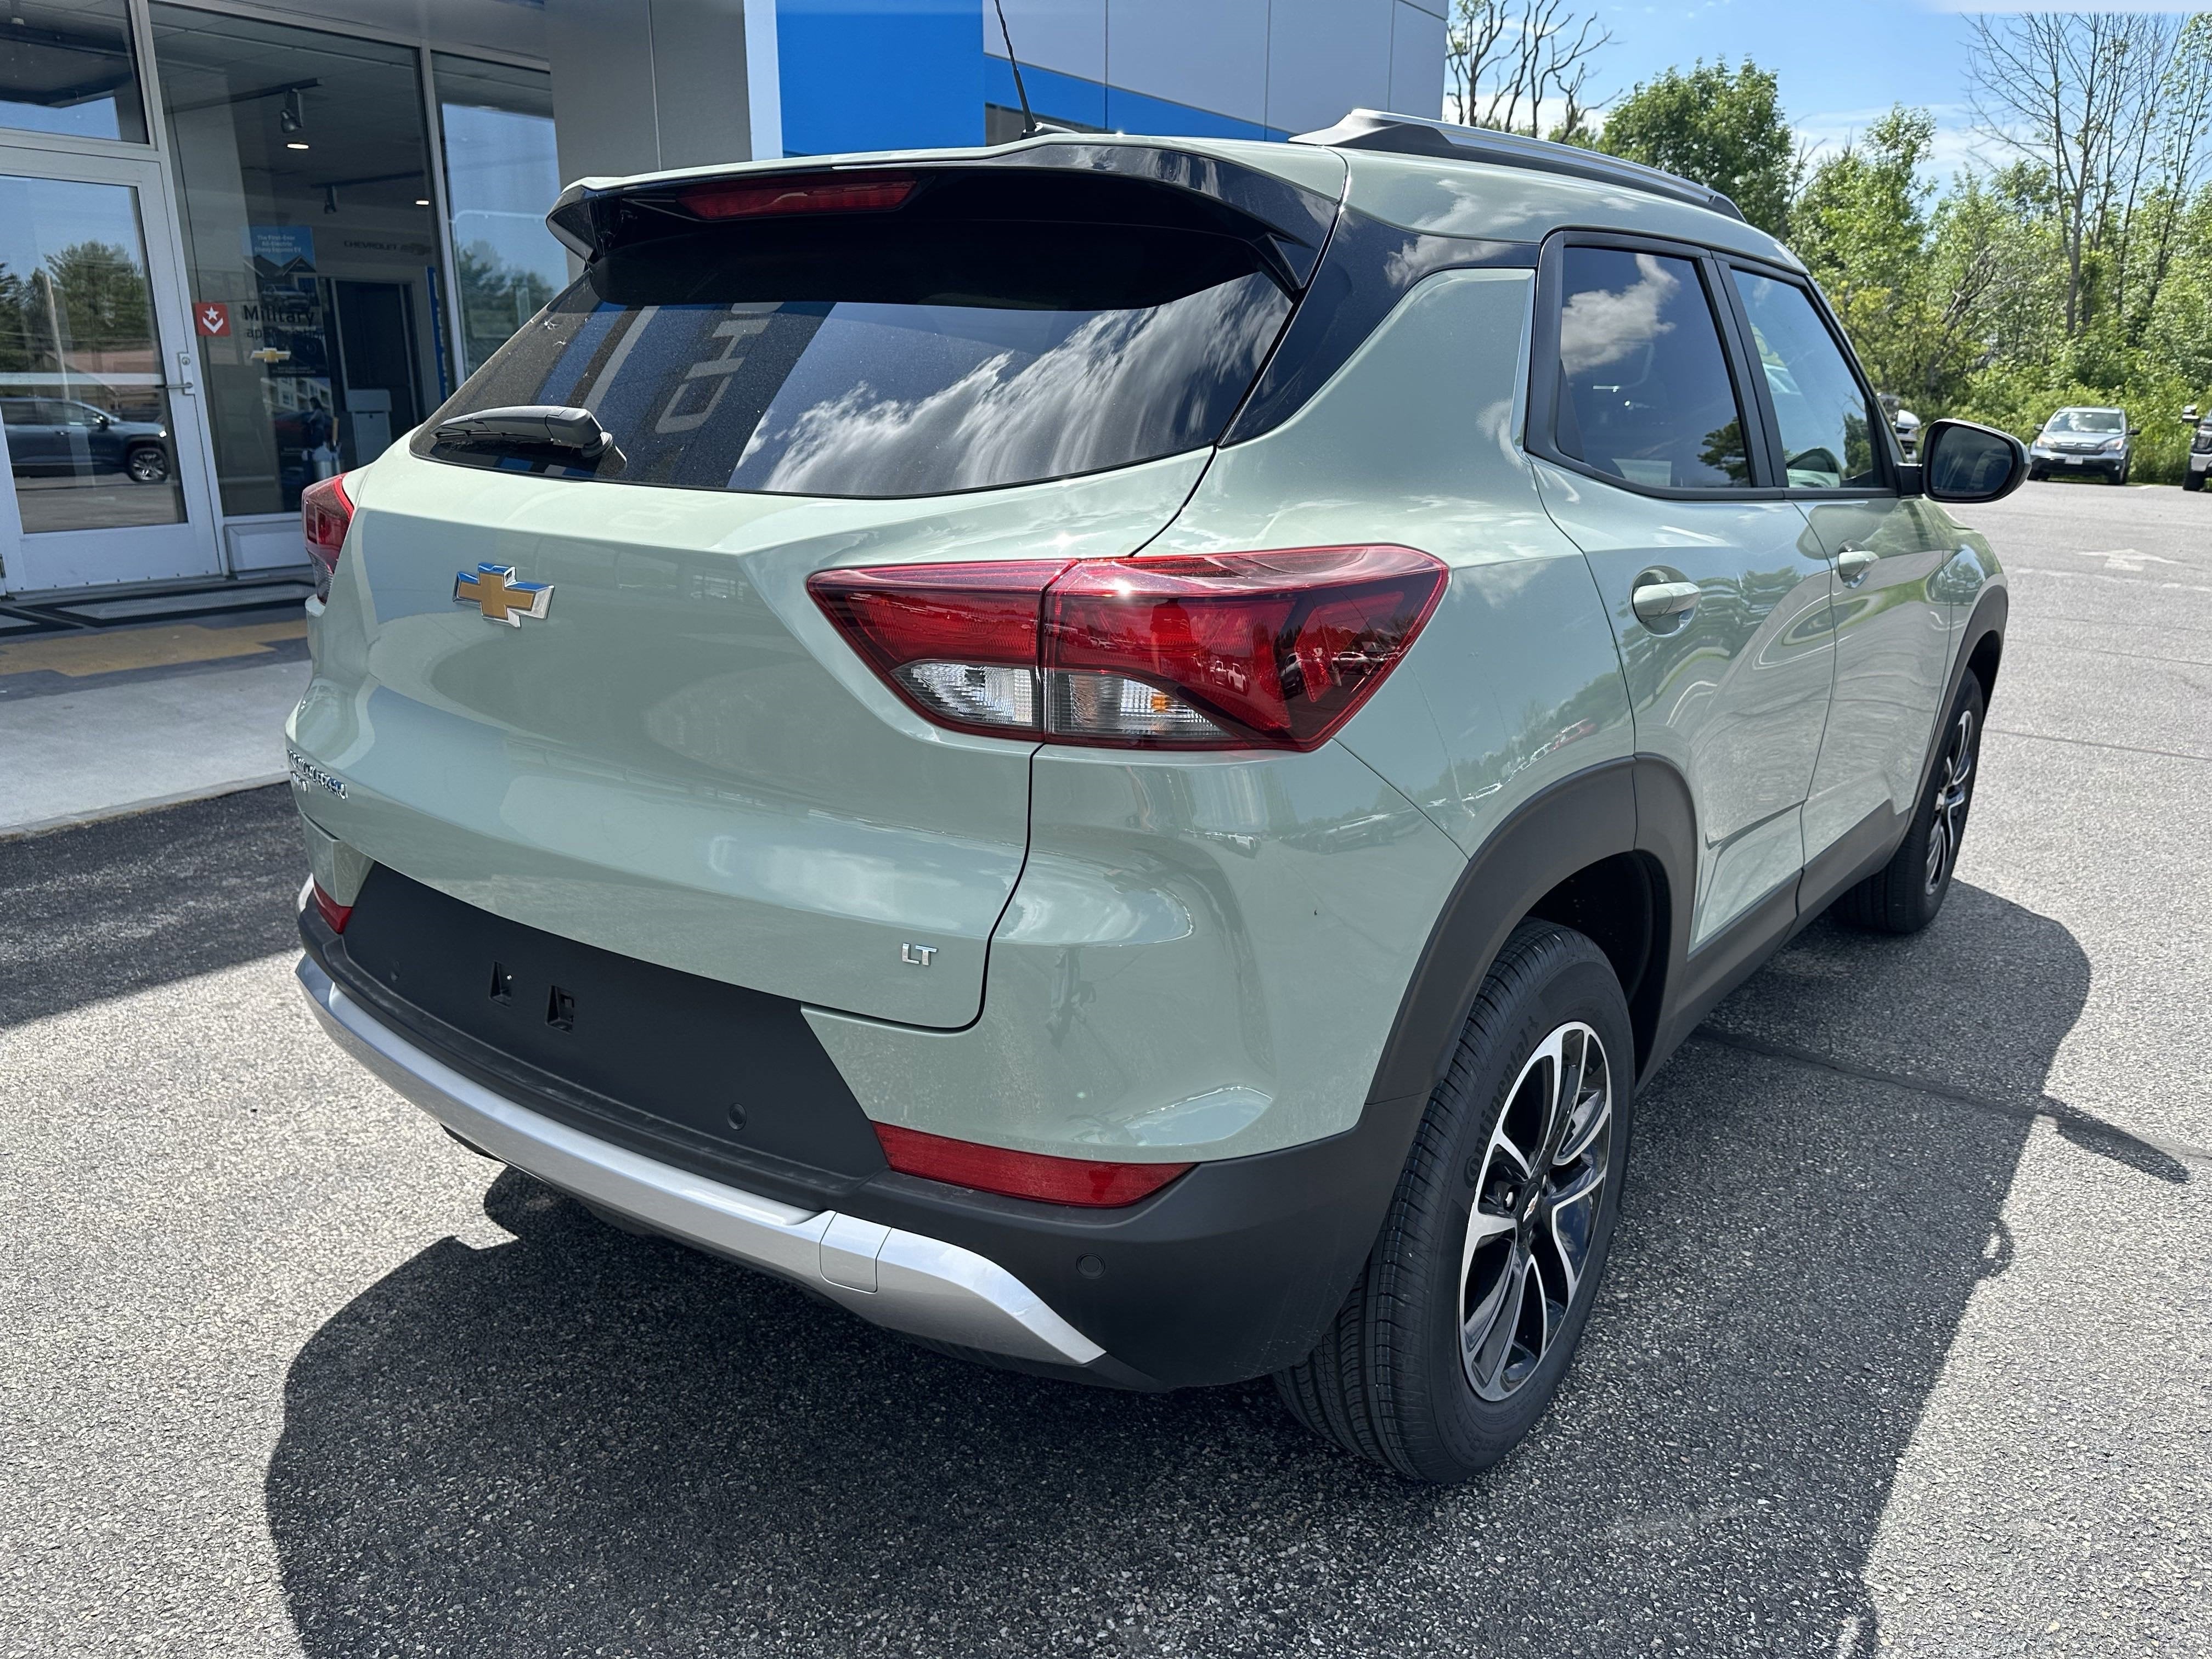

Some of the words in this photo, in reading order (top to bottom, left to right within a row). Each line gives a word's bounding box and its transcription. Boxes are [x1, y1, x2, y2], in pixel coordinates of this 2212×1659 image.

[243, 305, 314, 326] Military
[901, 943, 938, 966] LT
[1463, 1028, 1530, 1189] Continental
